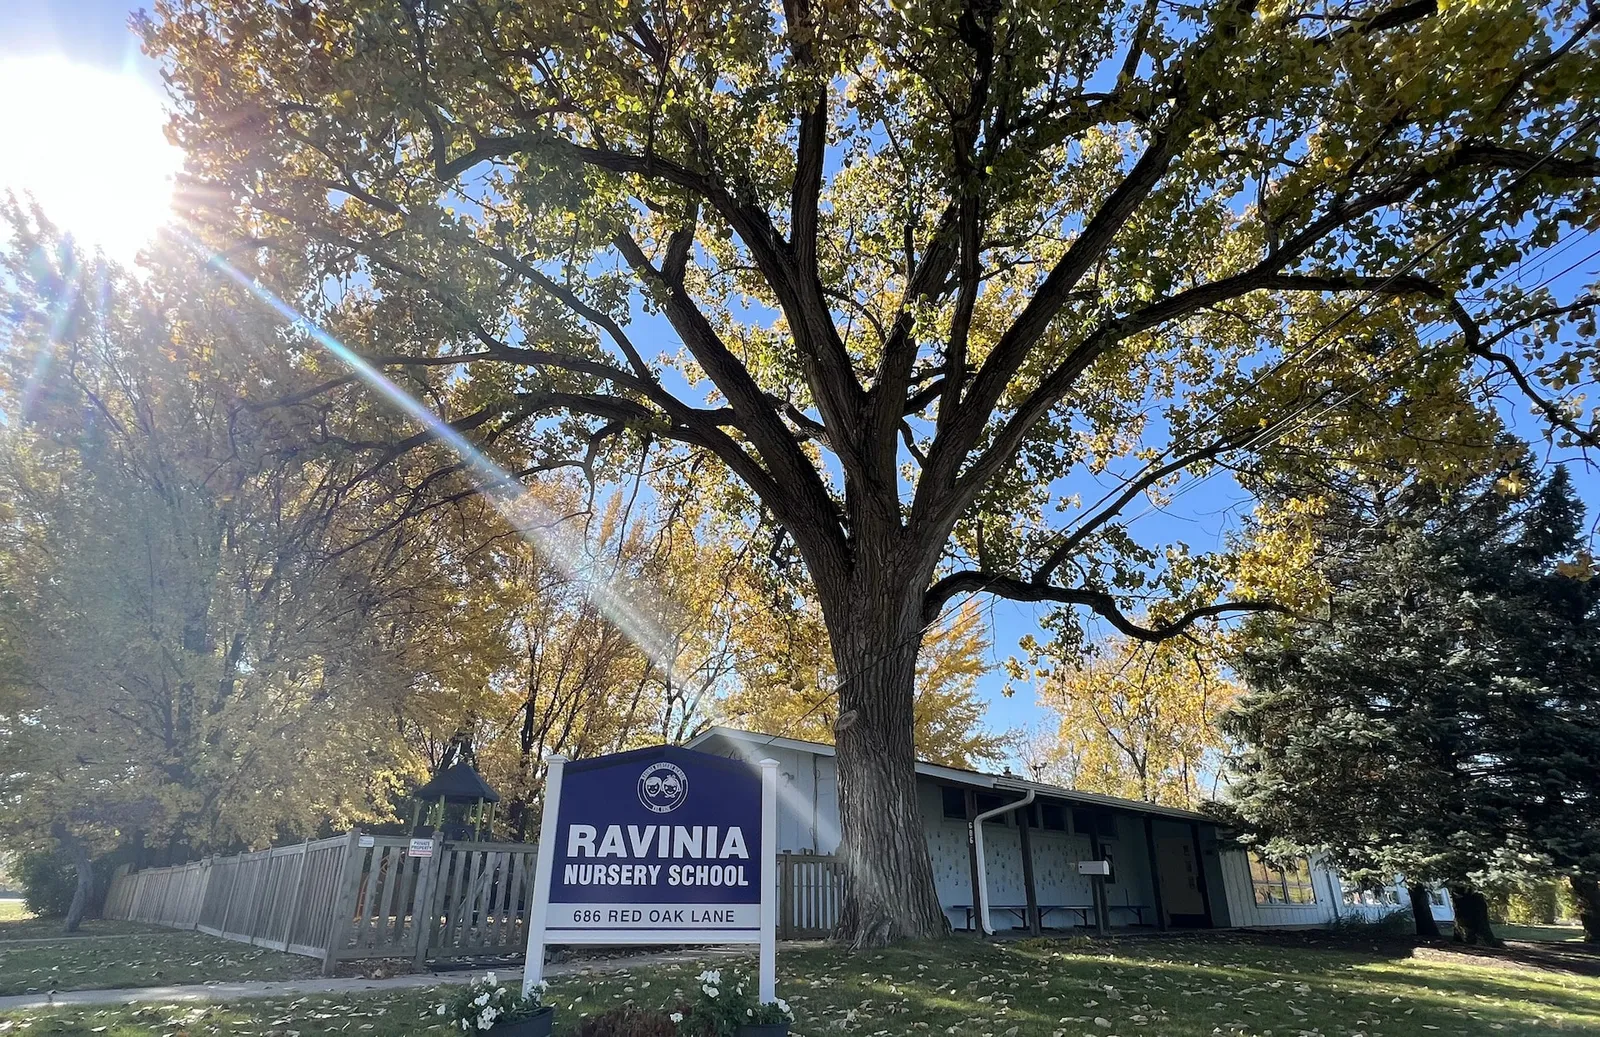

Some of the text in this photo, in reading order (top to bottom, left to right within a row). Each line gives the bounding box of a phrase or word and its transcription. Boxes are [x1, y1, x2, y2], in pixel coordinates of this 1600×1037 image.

[567, 824, 749, 859] RAVINIA
[563, 864, 749, 887] NURSERY SCHOOL
[573, 910, 735, 923] 686 RED OAK LANE
